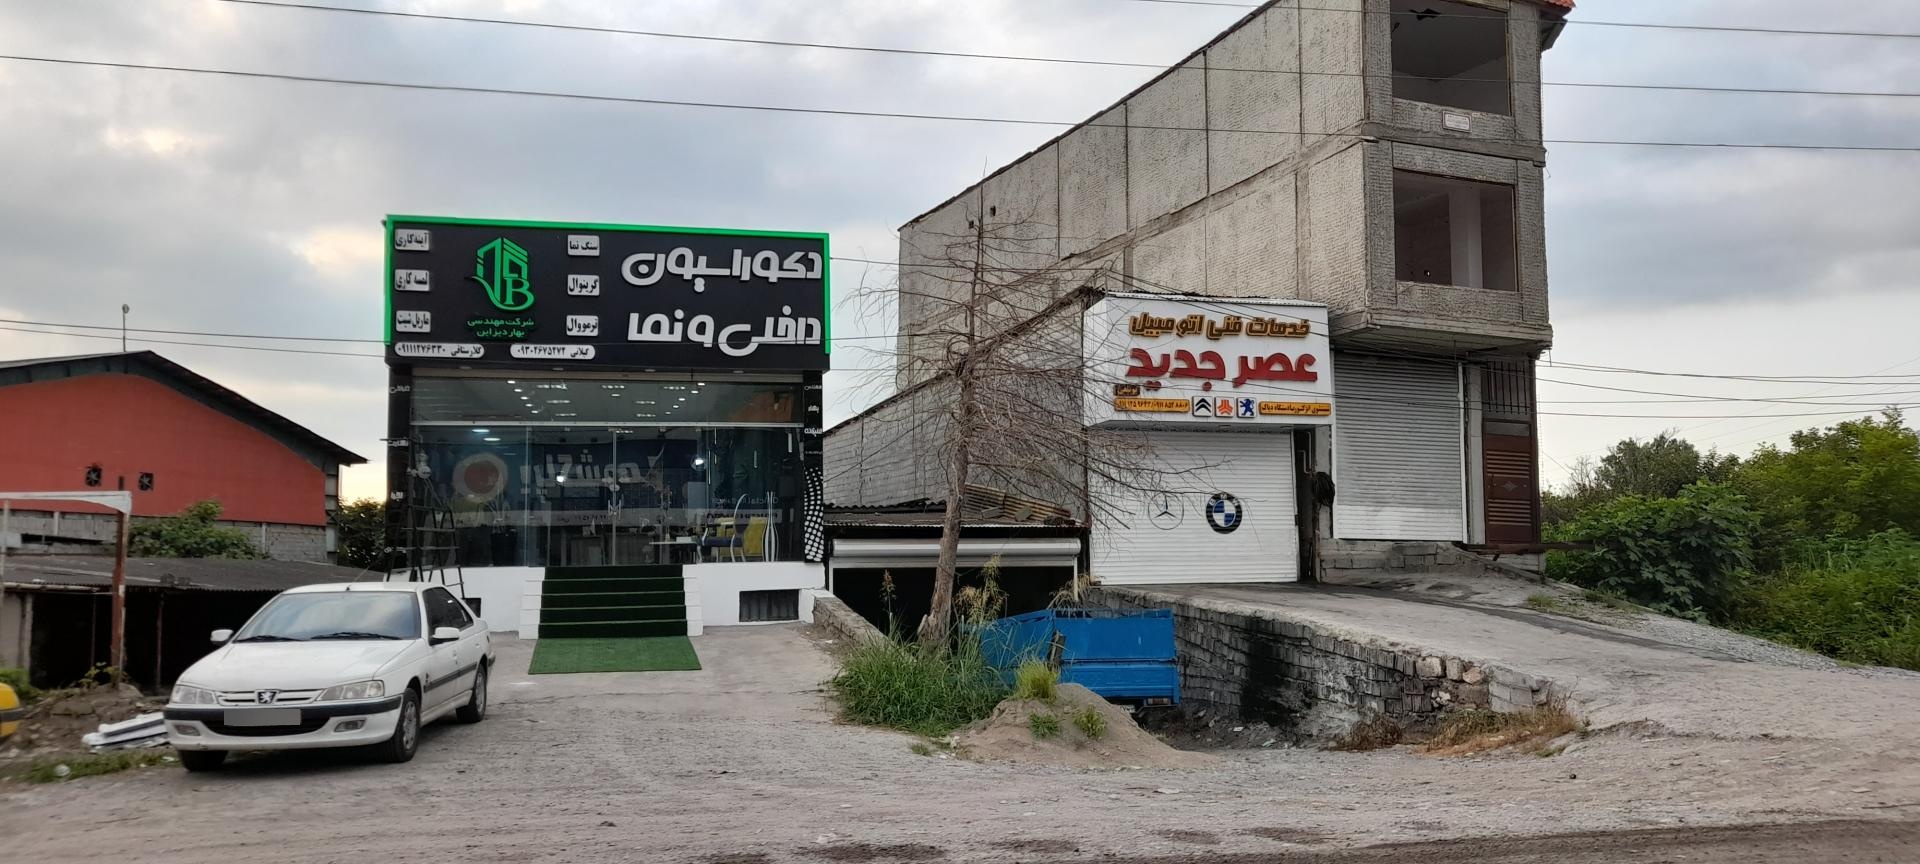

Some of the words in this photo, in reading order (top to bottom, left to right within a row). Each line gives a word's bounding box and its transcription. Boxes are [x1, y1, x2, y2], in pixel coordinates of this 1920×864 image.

[621, 247, 822, 292] دکوراسیون
[467, 318, 504, 327] مهندسی
[505, 318, 535, 327] شرکت
[627, 309, 684, 342] نما
[687, 315, 714, 347] و
[717, 305, 821, 357] داخلی
[1206, 315, 1243, 340] فنی
[1246, 317, 1310, 339] خدمات
[1125, 347, 1226, 392] جدید
[1232, 352, 1318, 389] عصر
